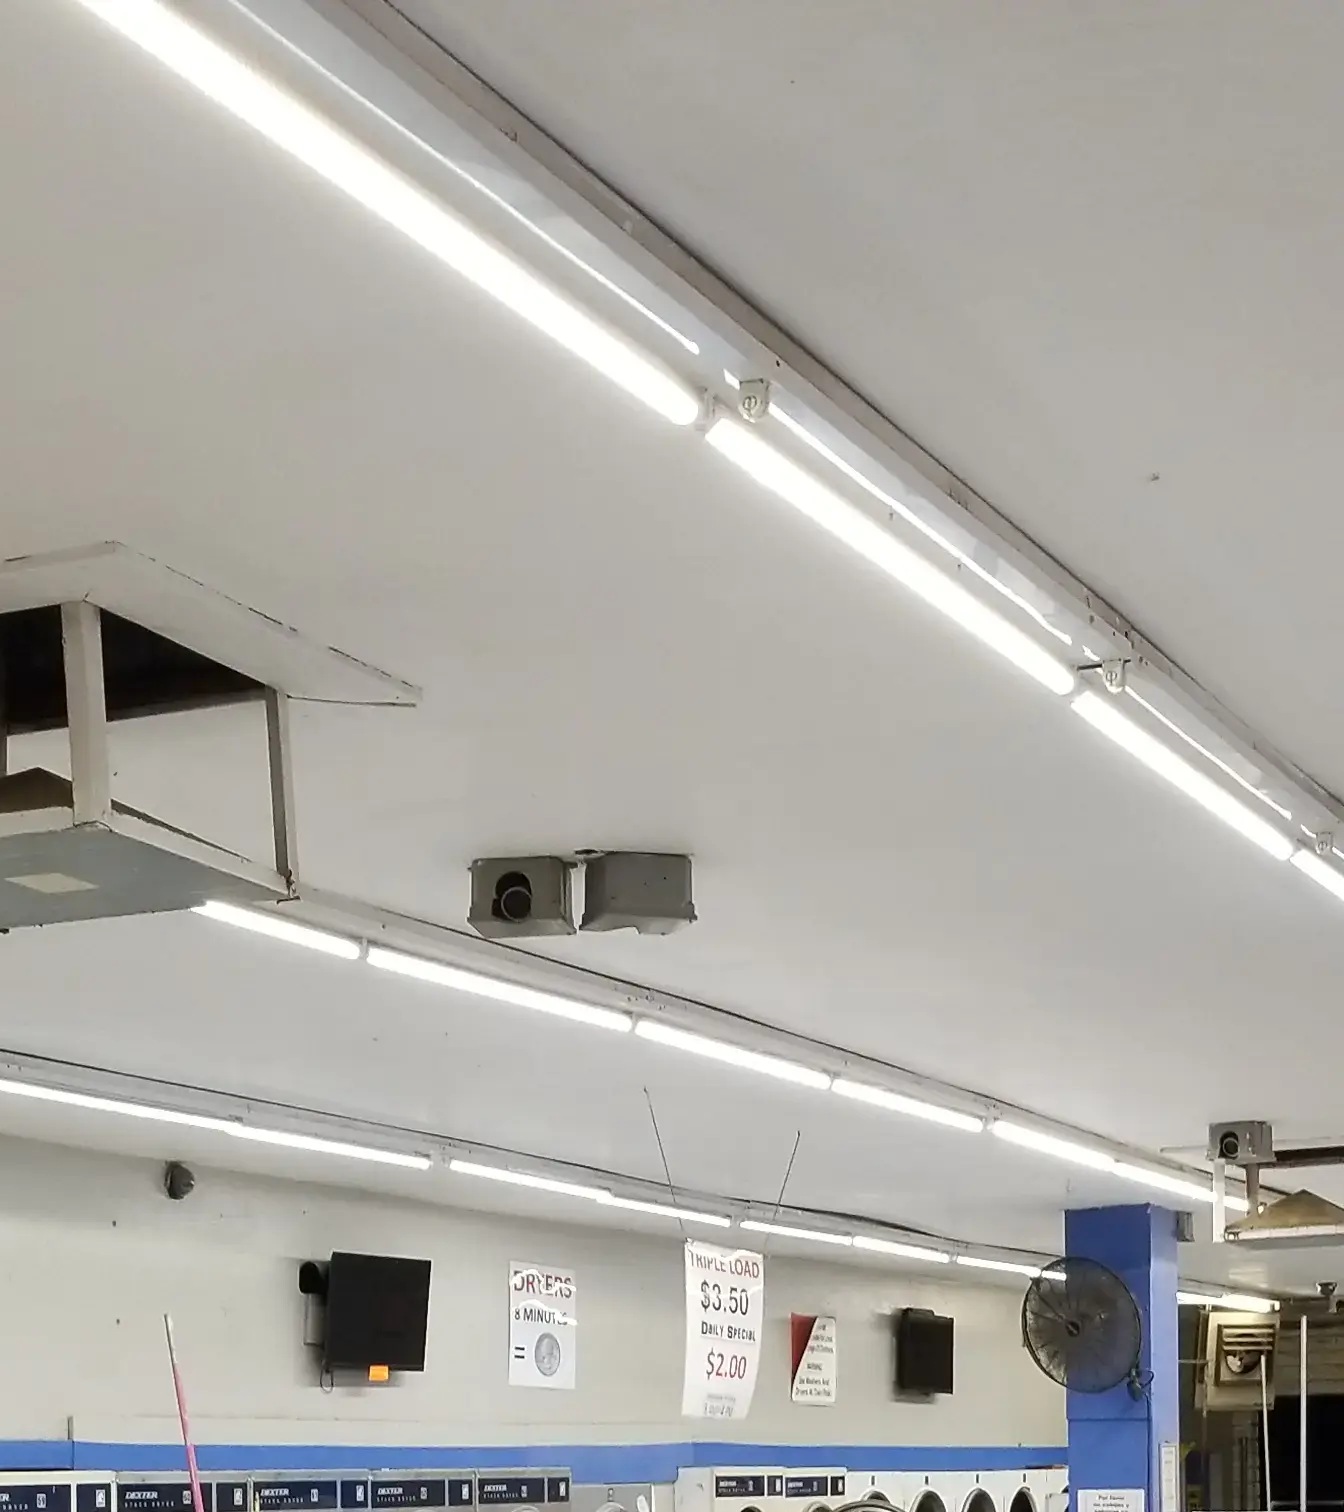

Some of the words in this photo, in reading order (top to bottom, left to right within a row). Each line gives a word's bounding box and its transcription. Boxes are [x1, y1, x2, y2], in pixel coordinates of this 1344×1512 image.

[688, 1250, 727, 1273] TRIPLE
[729, 1258, 760, 1279] LOAD
[701, 1280, 749, 1316] $3.50
[514, 1308, 521, 1320] 8
[706, 1348, 747, 1380] $2.00
[125, 1491, 158, 1500] DEXTER
[260, 1488, 289, 1496] DEXTER
[377, 1487, 403, 1495] DEXTER
